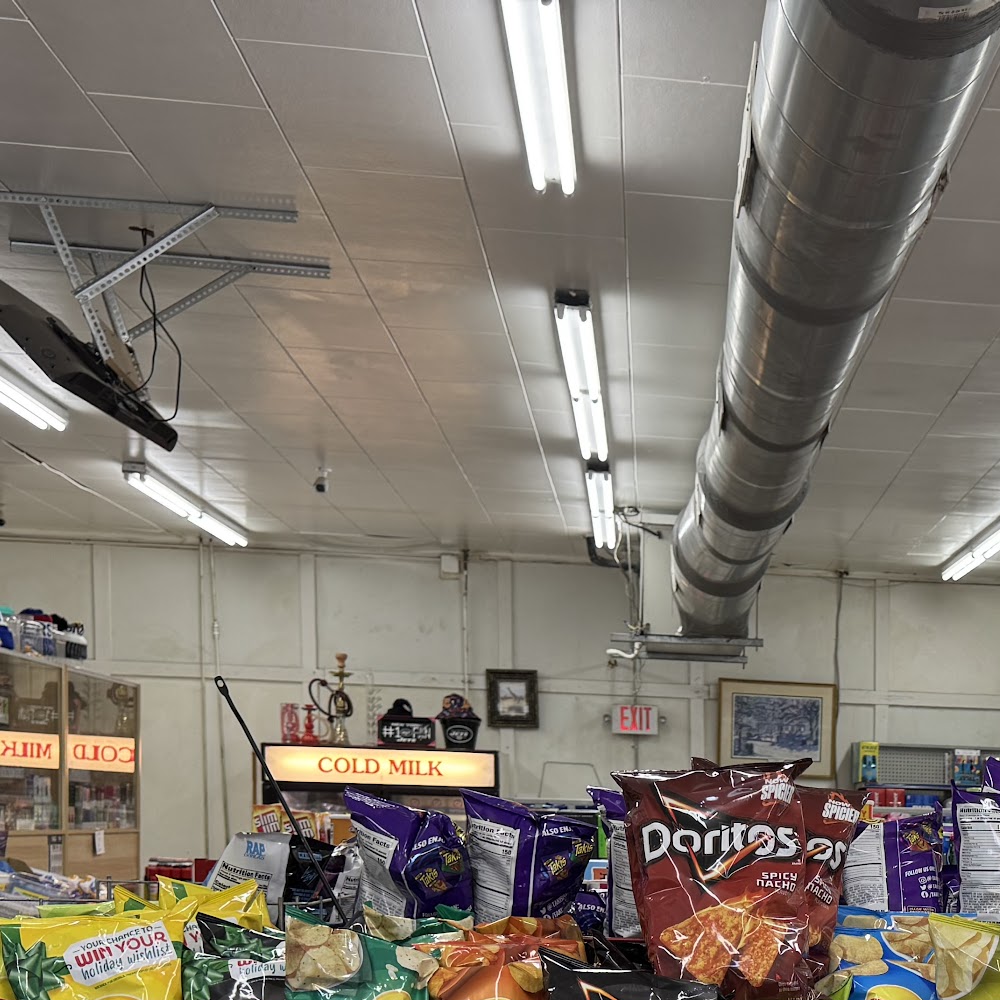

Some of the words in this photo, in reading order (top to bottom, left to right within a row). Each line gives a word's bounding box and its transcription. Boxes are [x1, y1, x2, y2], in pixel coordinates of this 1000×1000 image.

[620, 706, 652, 731] EXIT
[318, 757, 380, 774] COLD
[388, 760, 443, 776] MILK
[823, 806, 860, 822] SPICIER
[246, 840, 265, 855] RAP
[641, 823, 803, 863] Doritos
[222, 863, 253, 877] Nutrition
[255, 872, 271, 880] Facts
[761, 872, 798, 882] SPICY
[905, 869, 922, 877] FOLLOW
[757, 878, 797, 892] NACHO
[806, 884, 833, 904] NACHO
[80, 939, 105, 952] YOUR
[106, 929, 140, 945] CHANCE
[141, 926, 153, 935] TO
[75, 946, 112, 968] WIN
[114, 931, 167, 954] YOUR
[81, 959, 123, 980] holiday
[127, 944, 170, 967] wishlist
